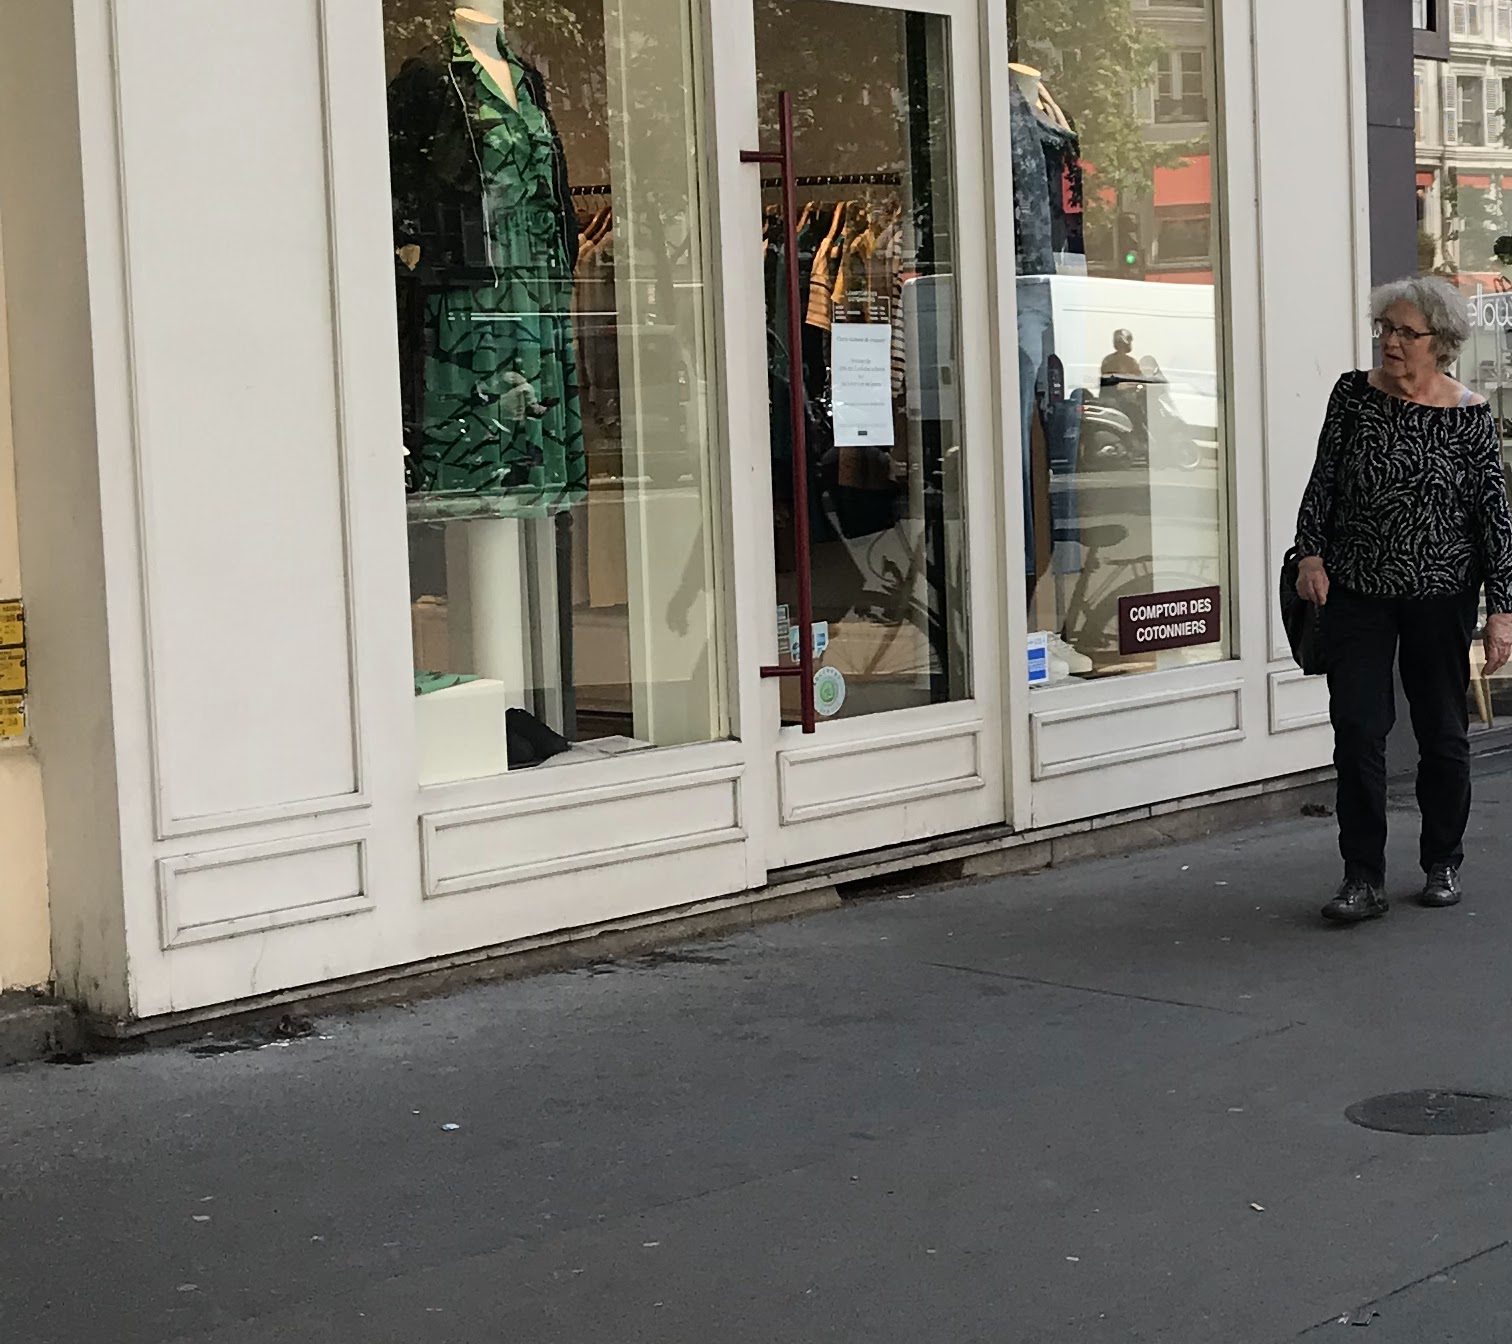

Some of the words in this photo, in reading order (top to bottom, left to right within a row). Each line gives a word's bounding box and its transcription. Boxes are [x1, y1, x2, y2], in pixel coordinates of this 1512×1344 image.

[1129, 600, 1188, 622] COMPTOIR
[1190, 597, 1212, 613] DES
[1136, 619, 1207, 643] COTONNIERS
